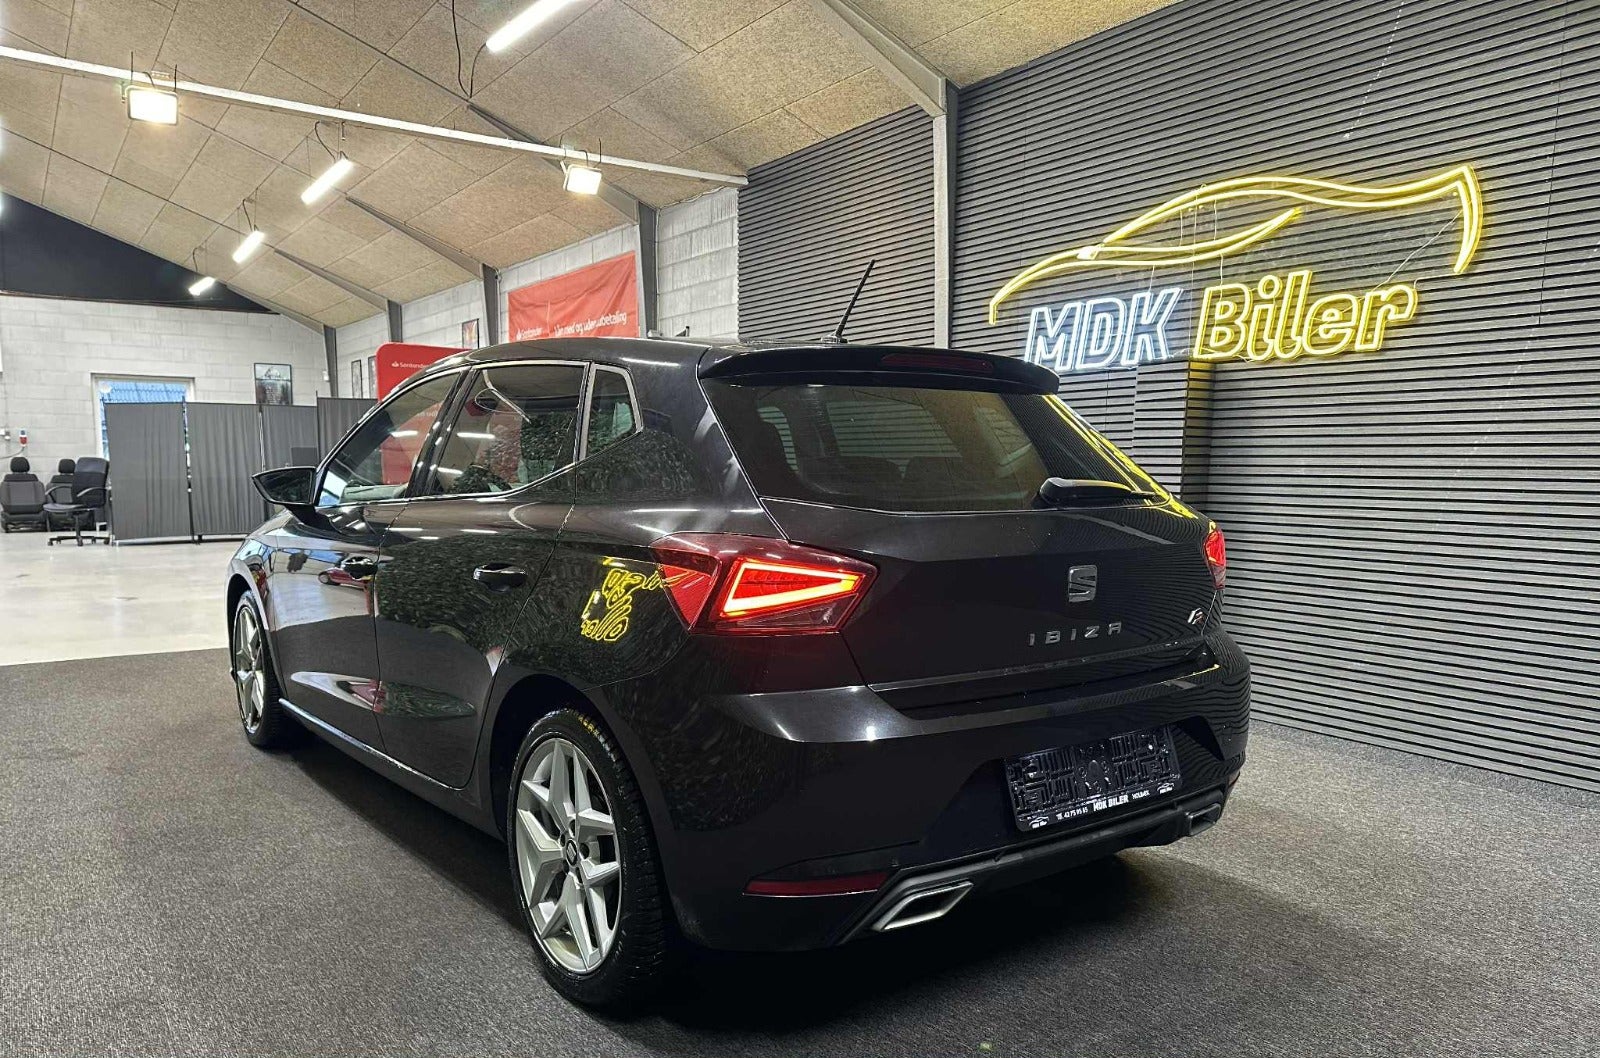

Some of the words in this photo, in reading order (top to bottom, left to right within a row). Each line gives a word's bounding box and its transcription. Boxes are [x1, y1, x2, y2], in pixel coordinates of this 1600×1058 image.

[1022, 286, 1184, 372] MDK
[1193, 270, 1418, 361] Biler
[1028, 621, 1123, 647] IBIZA
